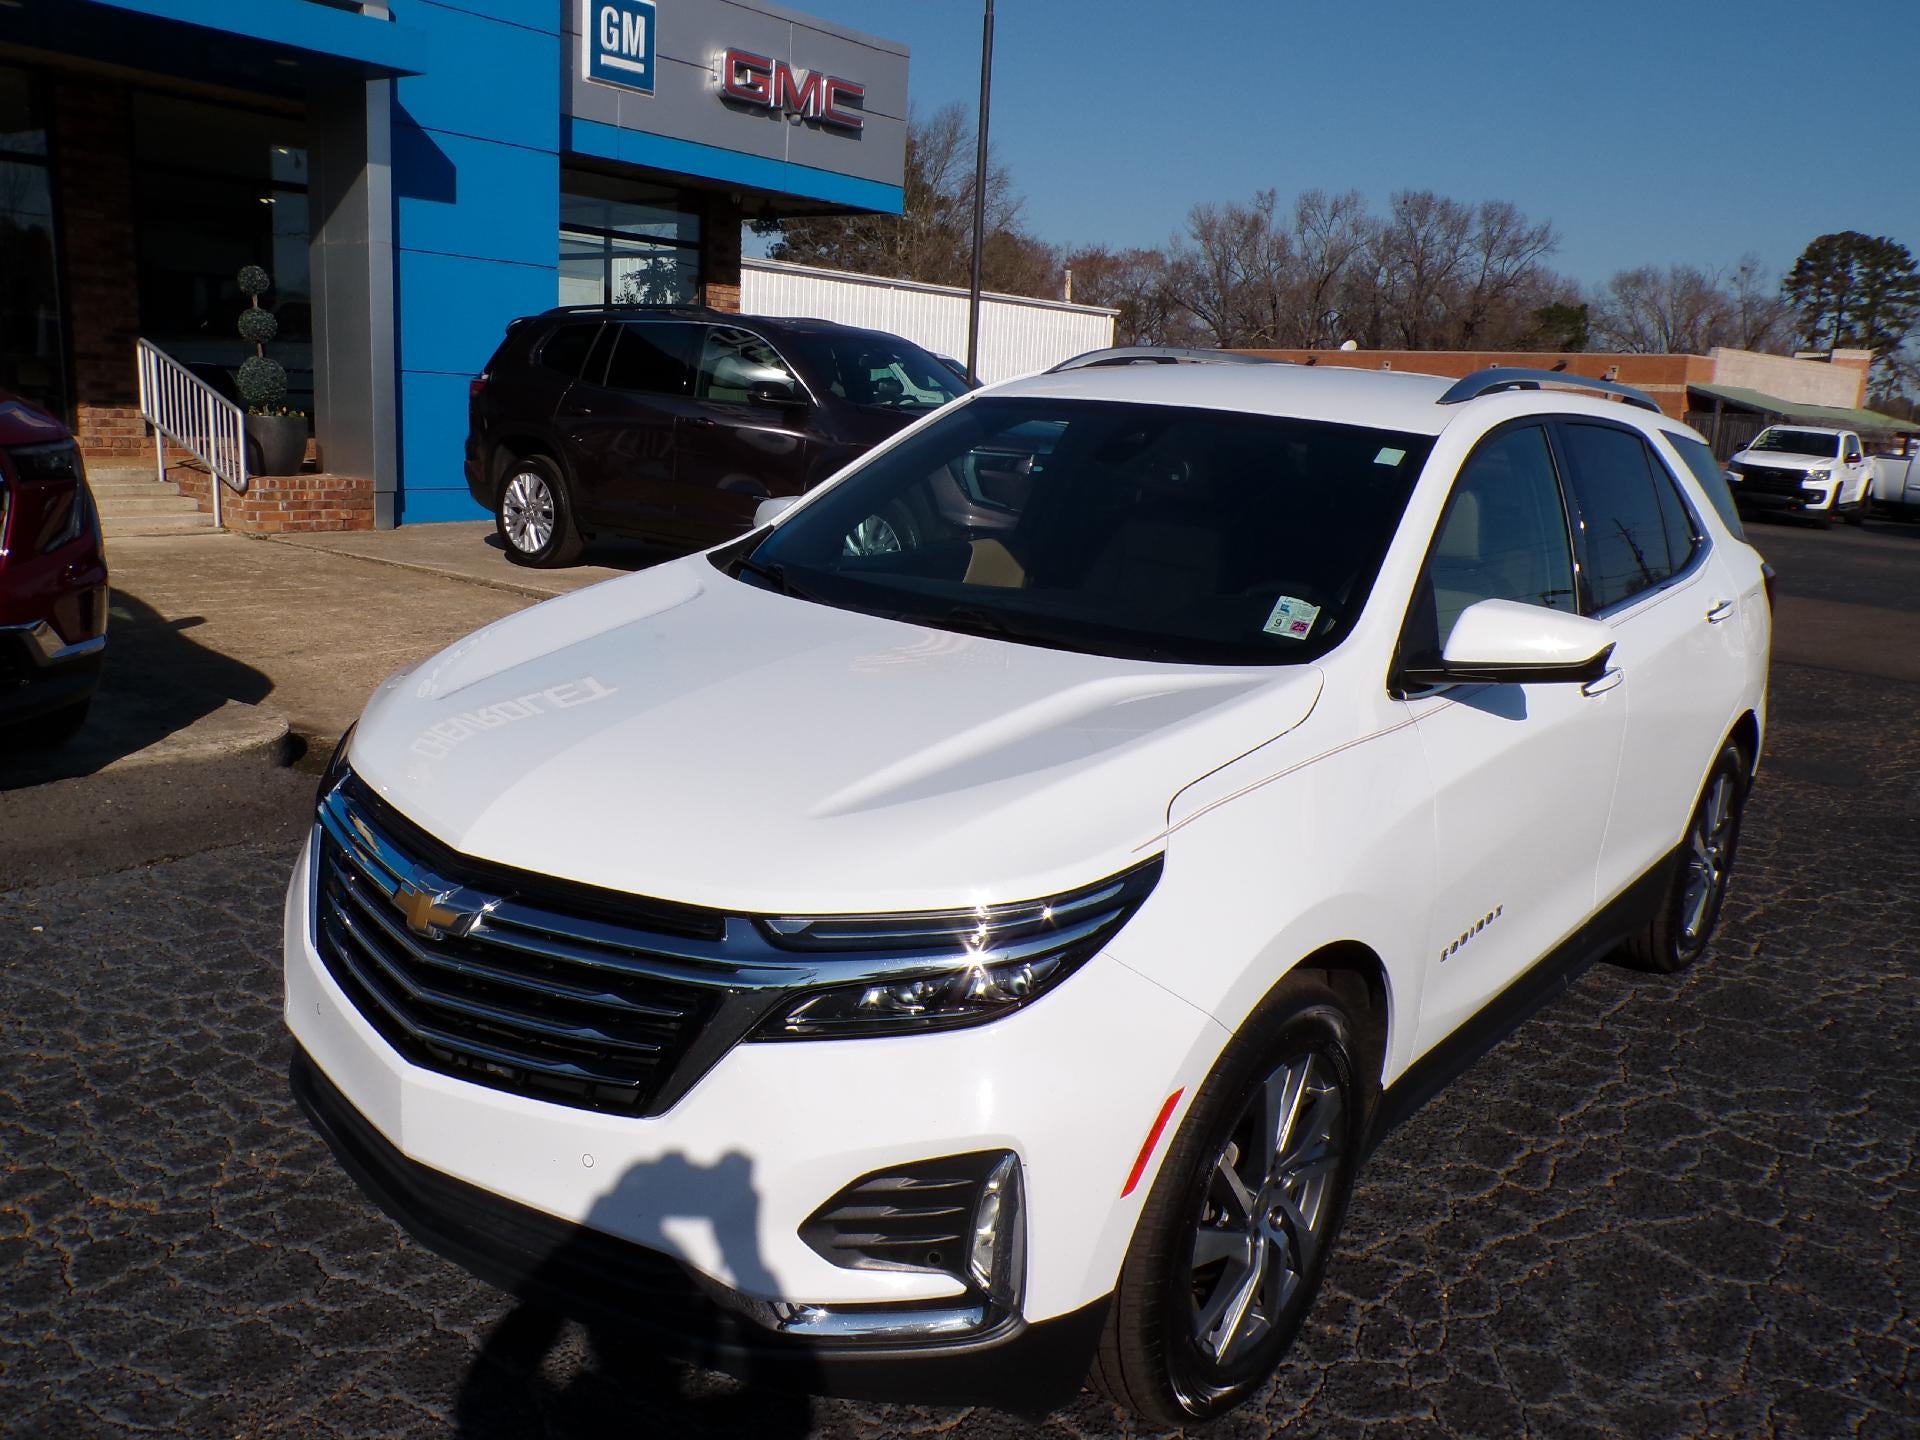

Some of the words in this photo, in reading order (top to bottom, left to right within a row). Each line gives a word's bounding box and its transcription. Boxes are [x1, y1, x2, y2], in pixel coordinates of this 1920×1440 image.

[600, 6, 646, 59] GM
[721, 48, 865, 130] GMC
[1274, 618, 1282, 627] 9
[1292, 621, 1308, 632] 25
